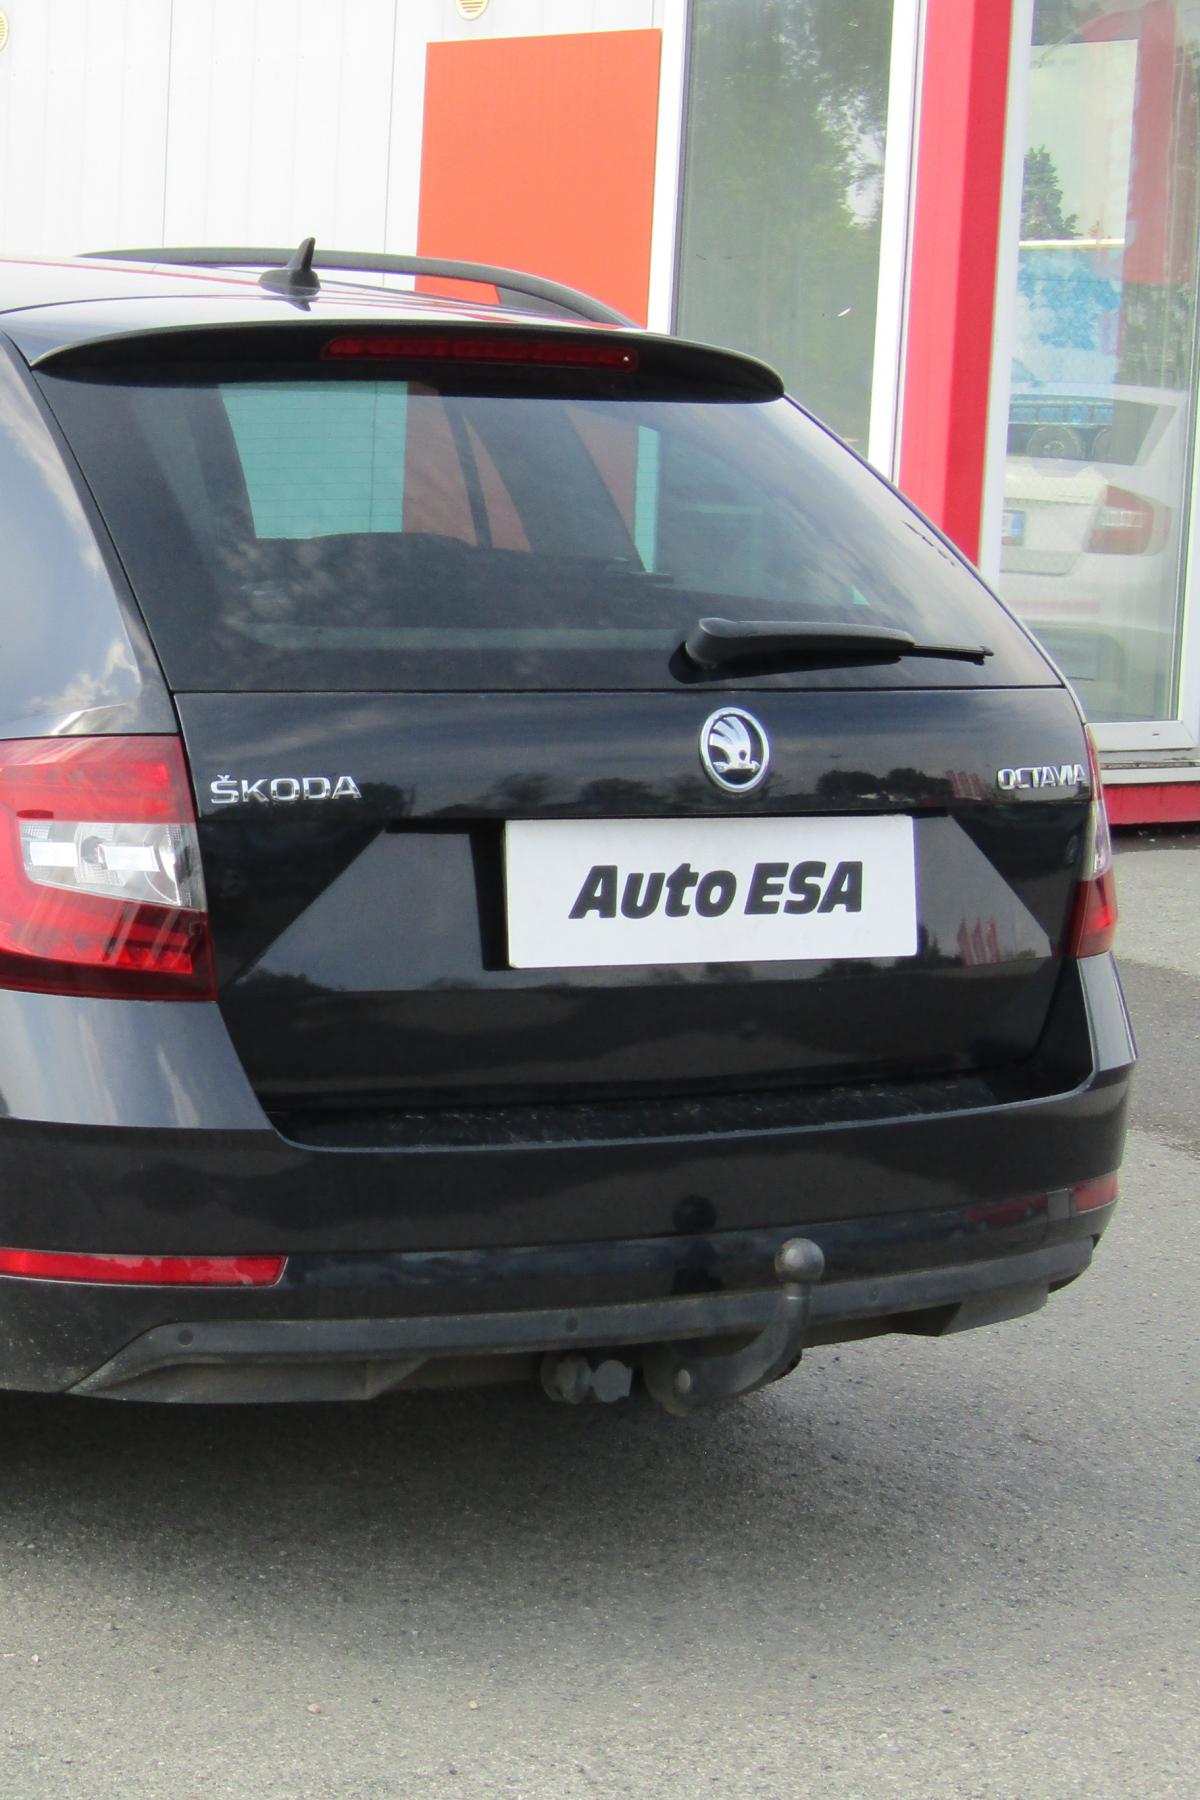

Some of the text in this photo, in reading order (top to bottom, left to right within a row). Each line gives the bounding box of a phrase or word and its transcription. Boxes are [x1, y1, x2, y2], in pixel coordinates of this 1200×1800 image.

[210, 774, 363, 804] ŠKODA
[997, 764, 1088, 790] OCTAVIA
[568, 861, 863, 919] Auto ESA
